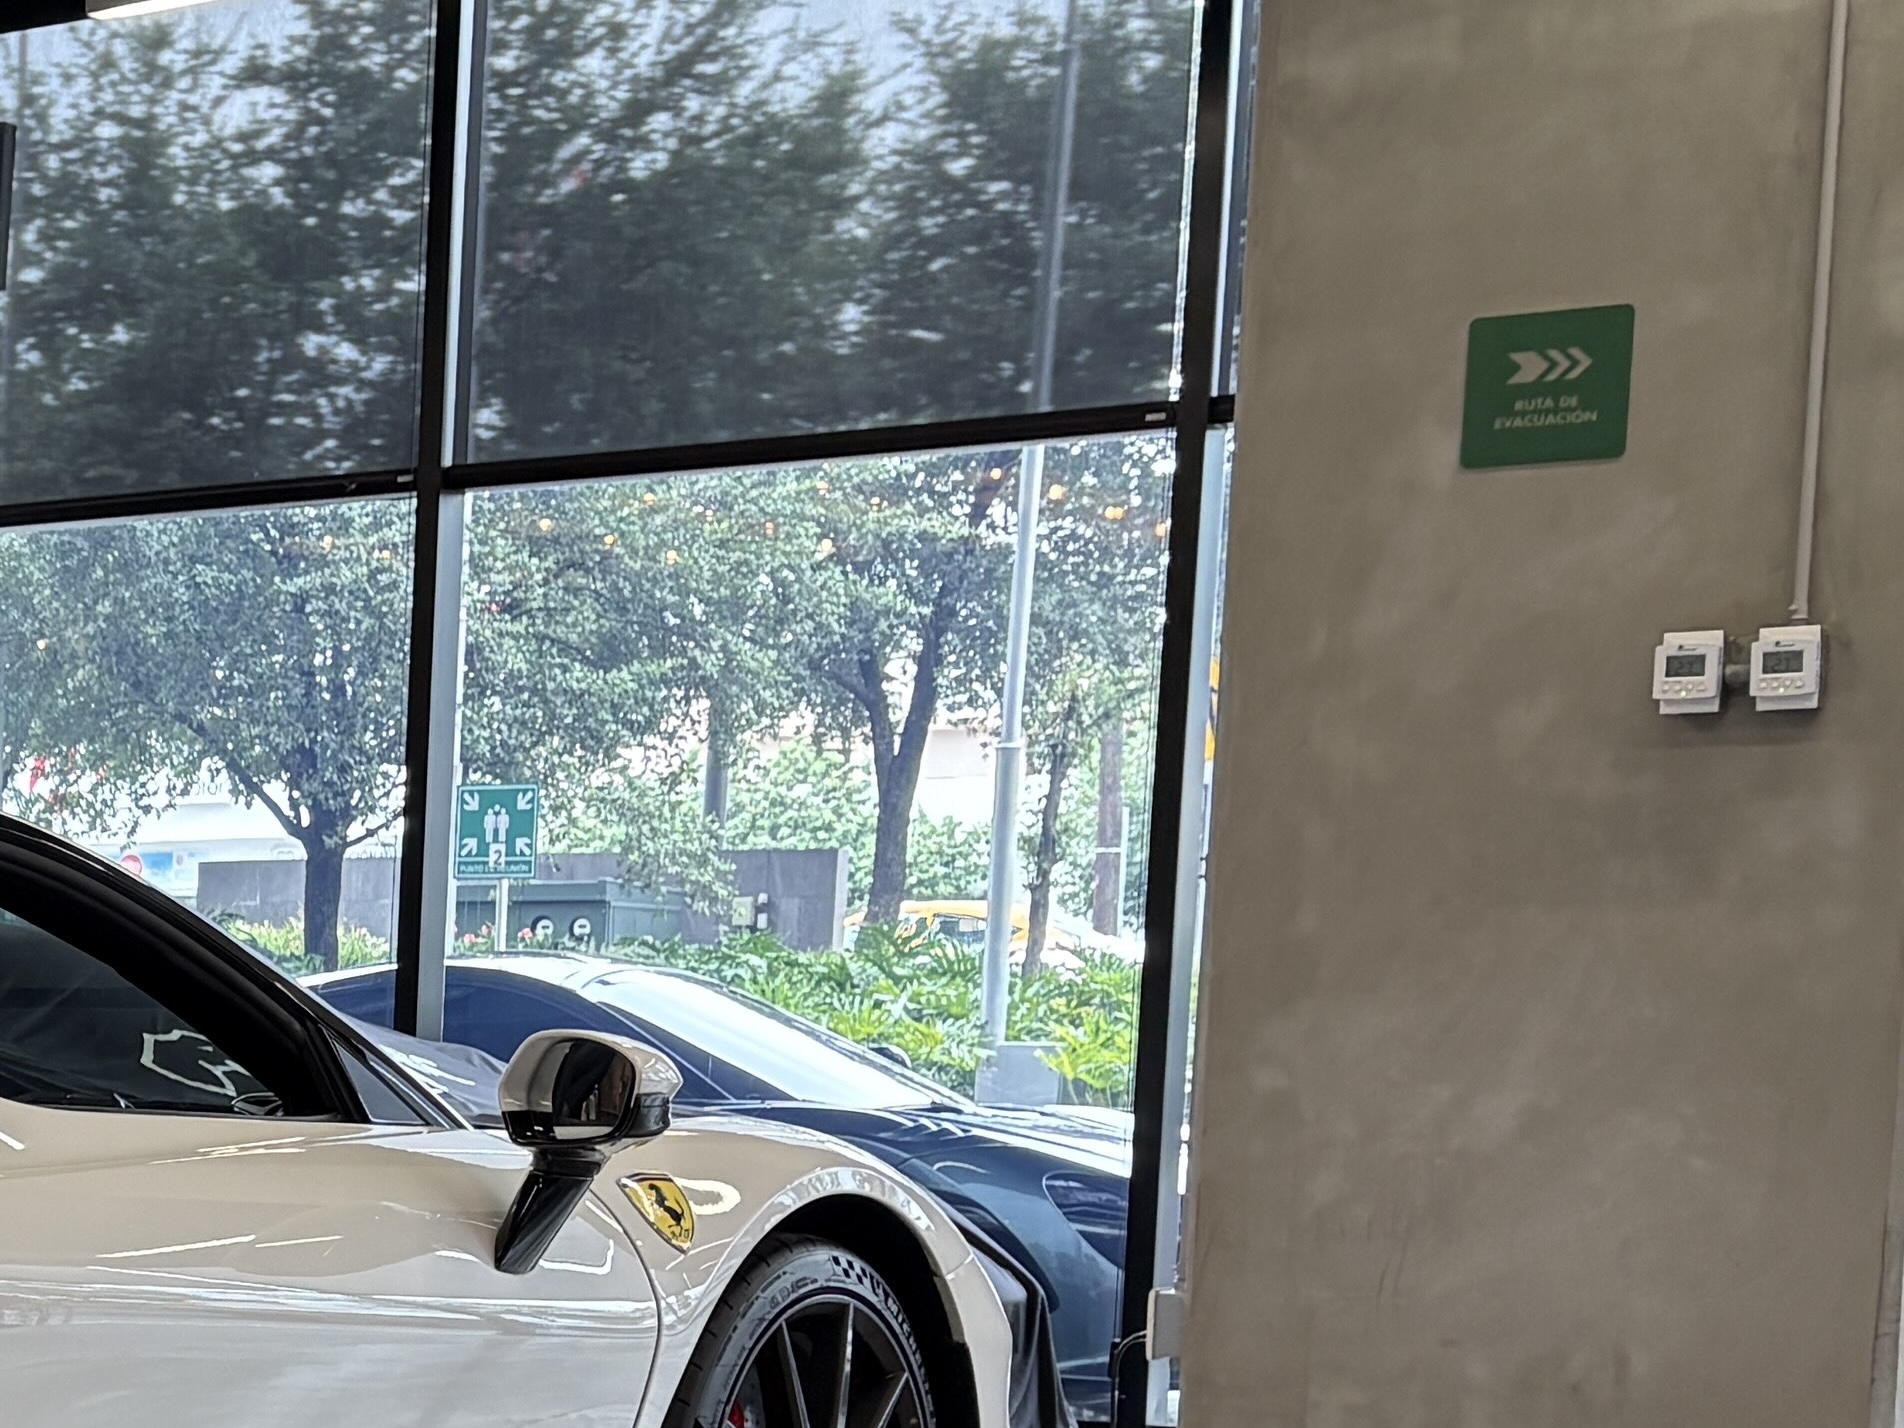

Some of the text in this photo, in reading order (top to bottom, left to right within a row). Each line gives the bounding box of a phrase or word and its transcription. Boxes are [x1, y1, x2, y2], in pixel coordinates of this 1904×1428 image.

[1514, 394, 1578, 411] RUTA DE
[1494, 409, 1598, 429] EVACUACIÓN
[493, 849, 502, 866] 2
